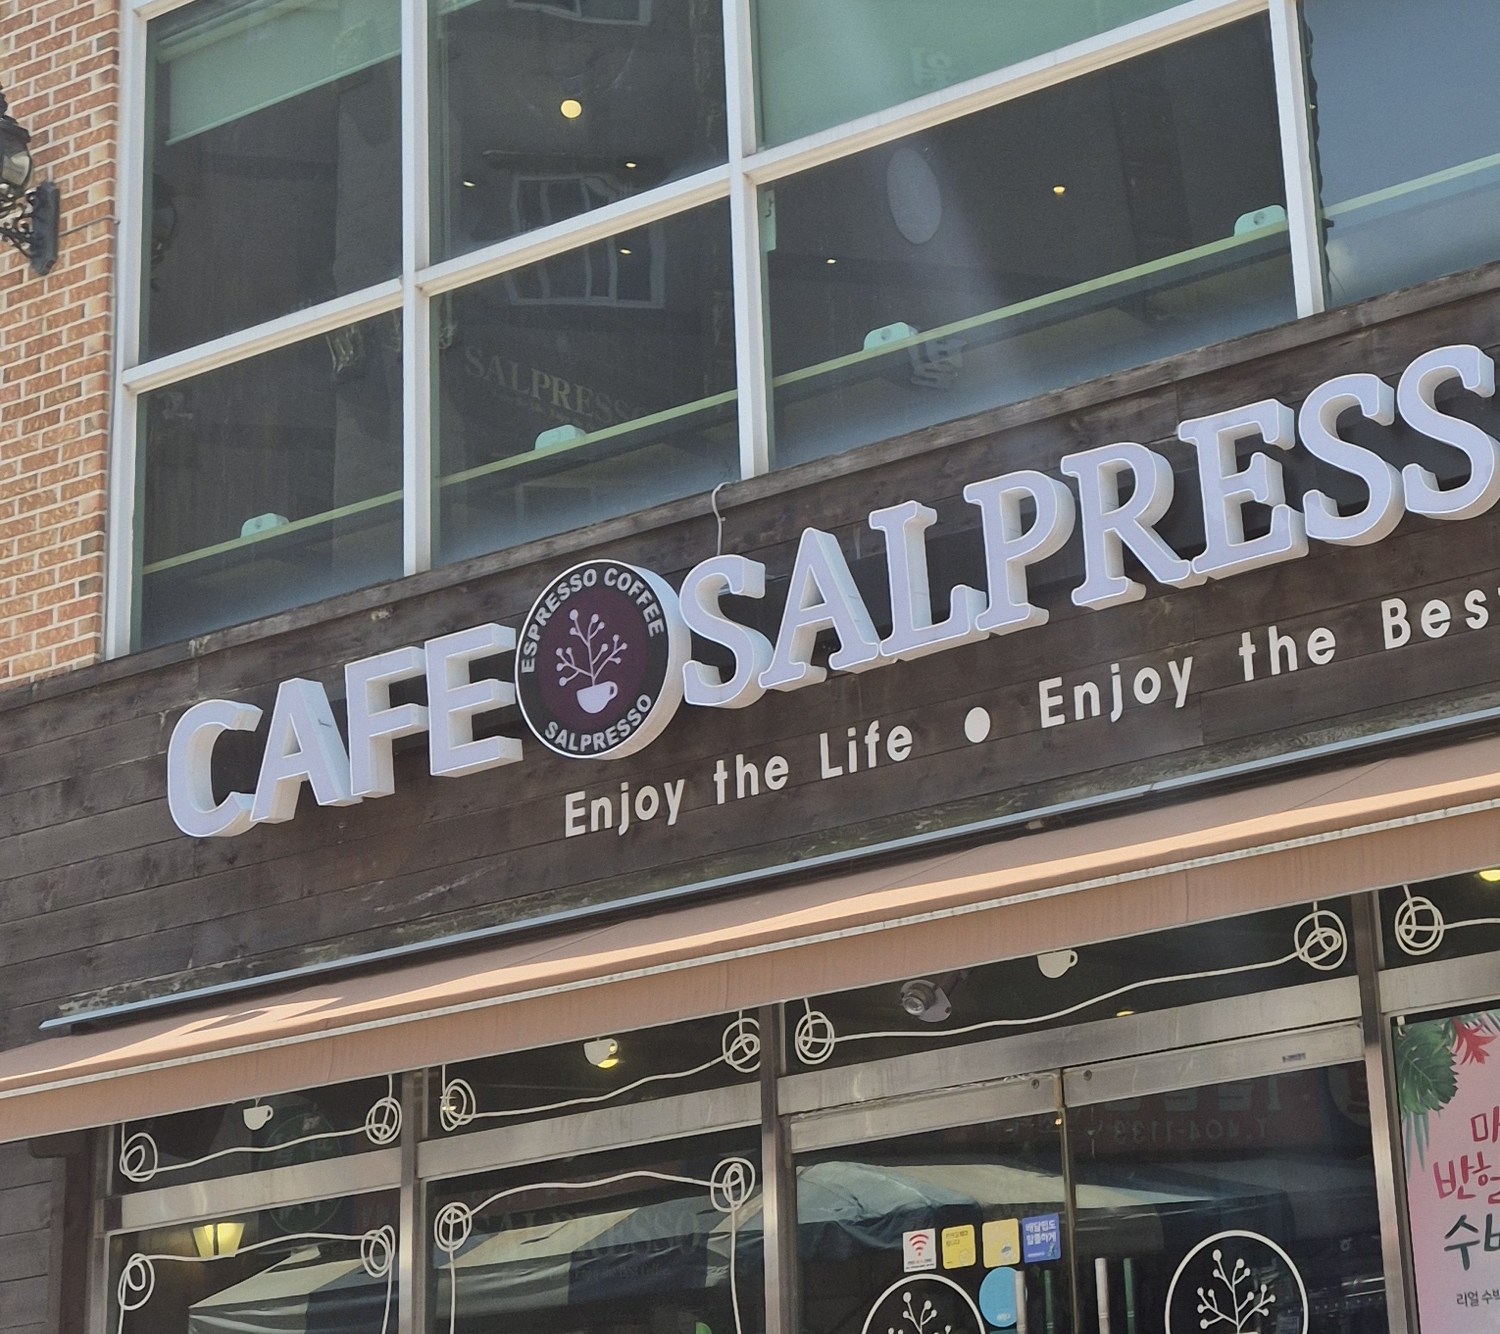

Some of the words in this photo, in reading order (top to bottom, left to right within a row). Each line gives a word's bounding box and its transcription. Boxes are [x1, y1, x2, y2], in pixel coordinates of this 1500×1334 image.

[521, 568, 598, 673] ESPRESSO
[604, 567, 665, 637] COFFEE
[167, 622, 524, 839] CAFE
[544, 693, 652, 753] SALPRESSO
[564, 779, 685, 839] Enjoy
[713, 756, 789, 806] the
[819, 719, 914, 780] Life
[1037, 650, 1194, 729] Enjoy
[1239, 625, 1336, 683] the
